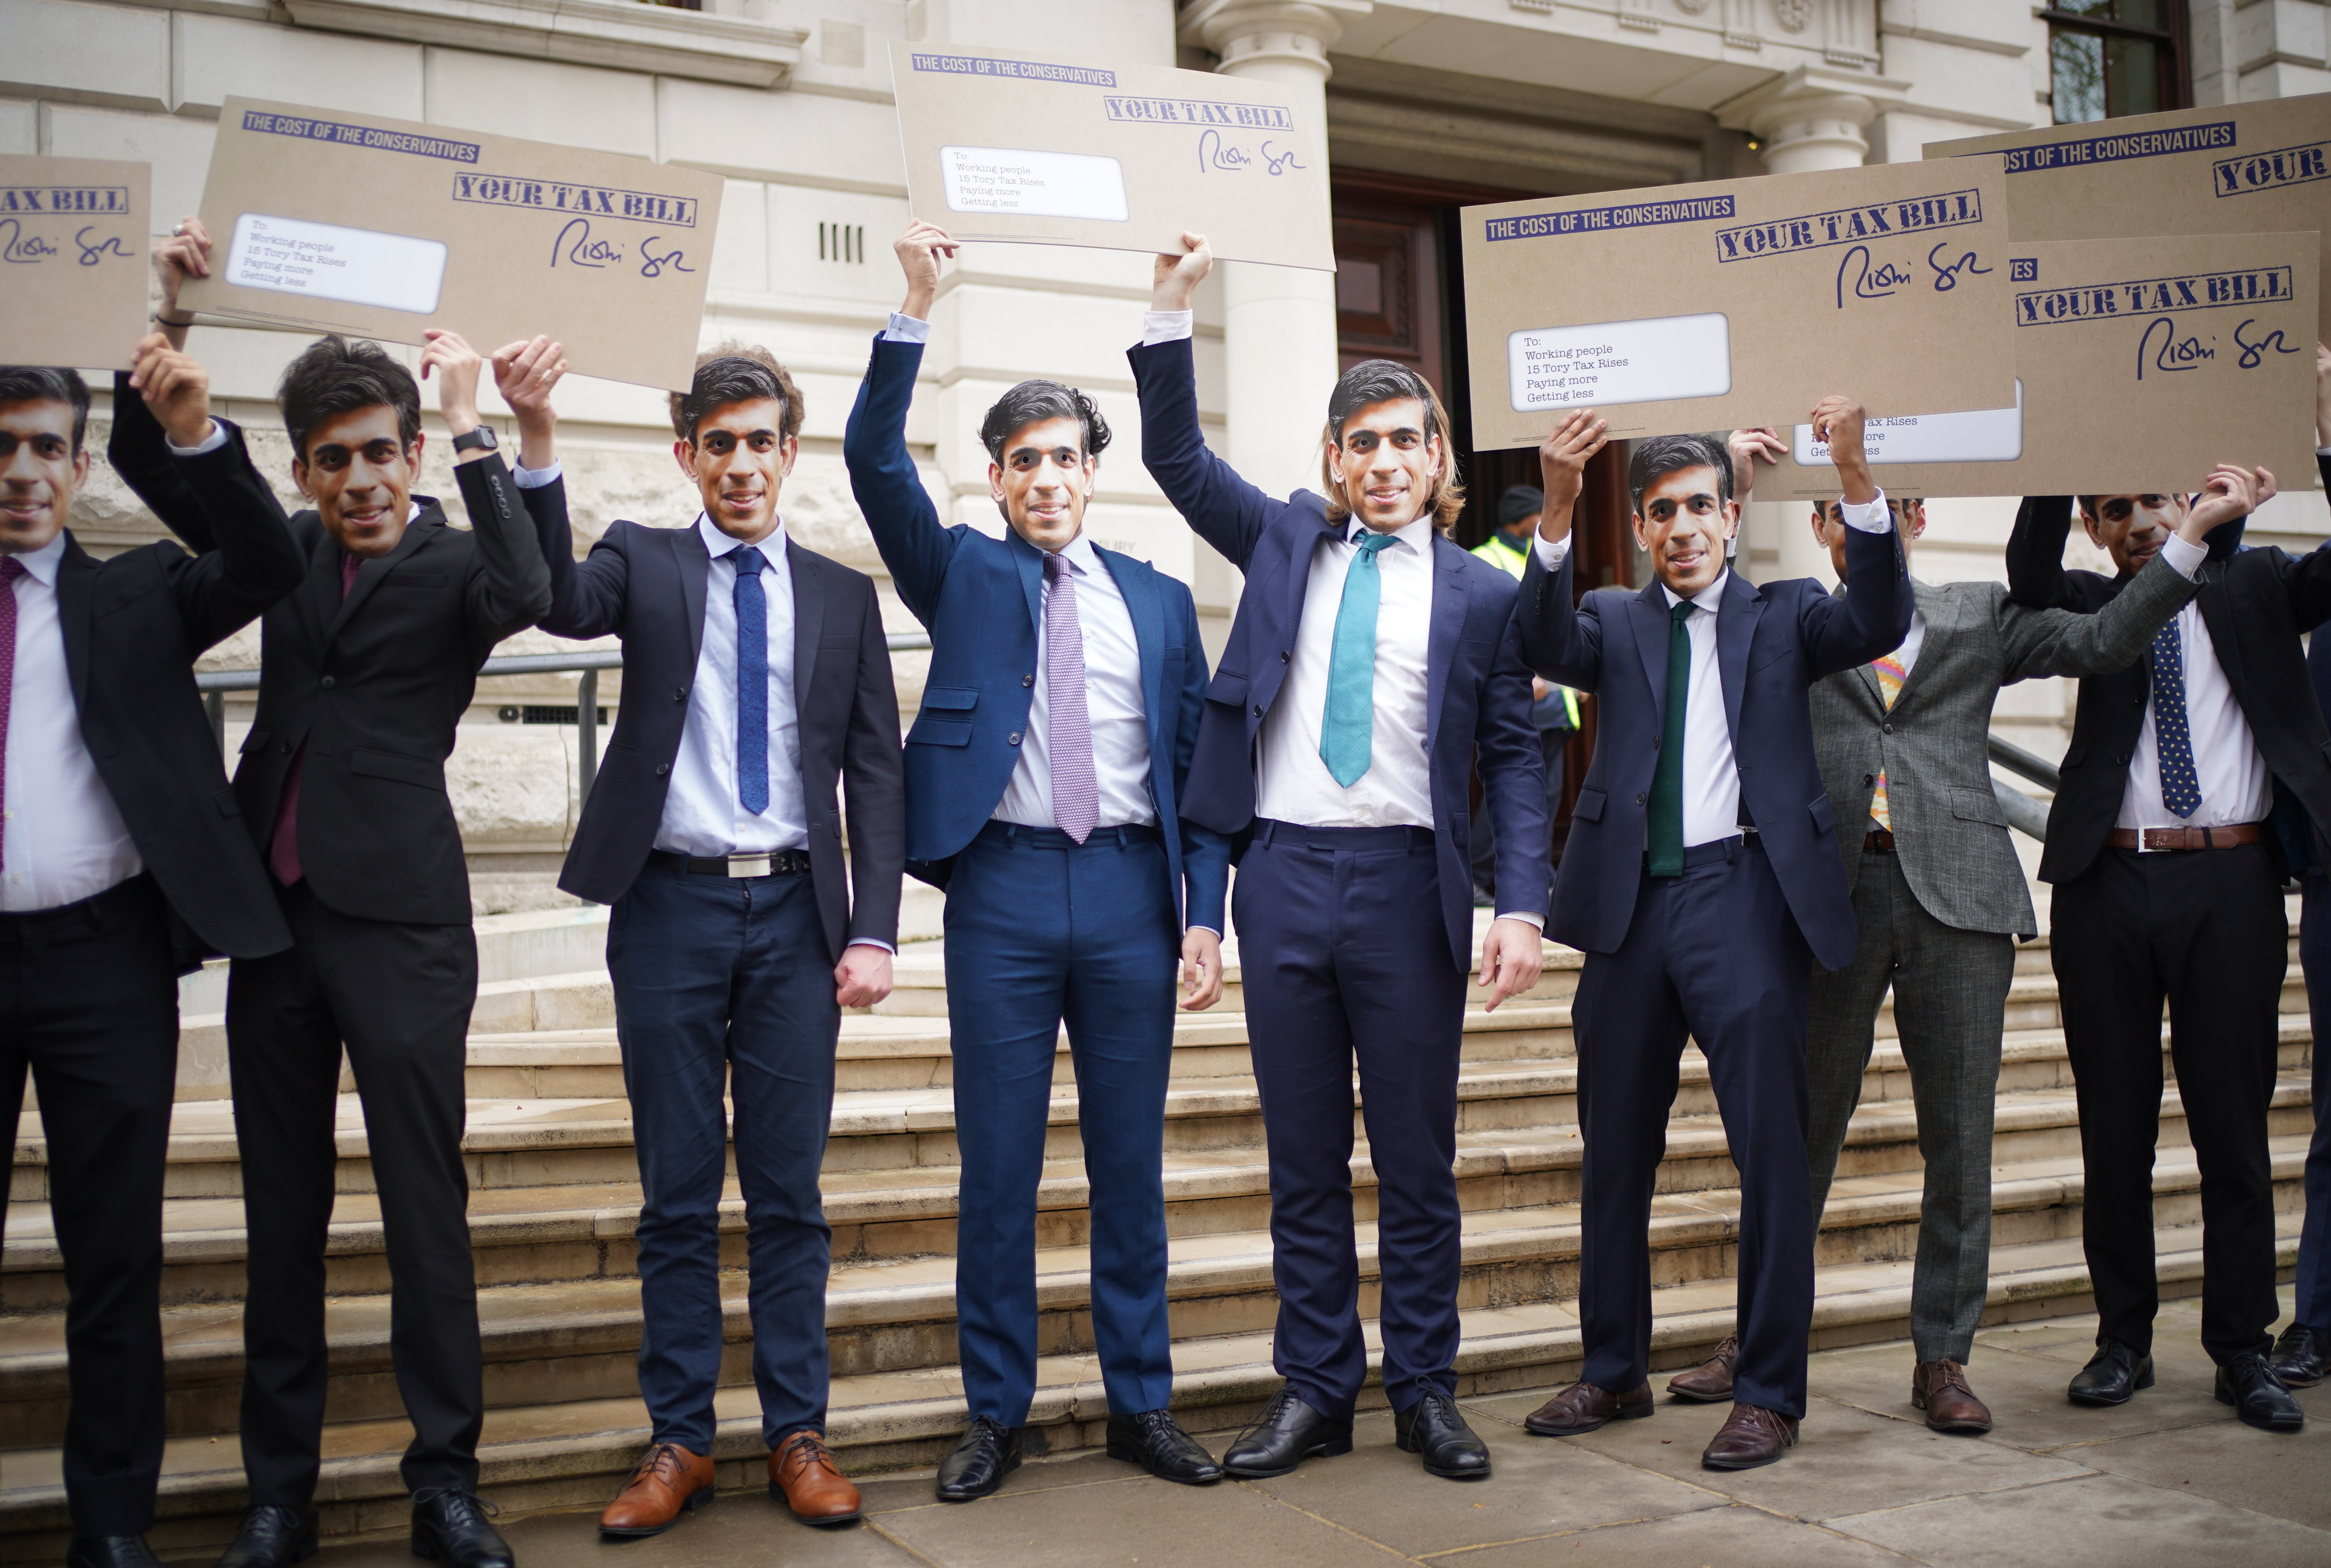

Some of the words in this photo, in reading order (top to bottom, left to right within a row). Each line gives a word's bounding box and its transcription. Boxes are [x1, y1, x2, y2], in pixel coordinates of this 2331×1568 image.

[914, 56, 939, 70] THE
[941, 58, 972, 71] COST
[976, 61, 990, 73] OF
[993, 62, 1018, 75] THE
[1020, 64, 1113, 85] CONSERVATIVES
[1107, 99, 1178, 120] YOUR
[1180, 103, 1232, 123] TAX
[1235, 106, 1289, 127] BILL
[246, 113, 273, 130] THE
[275, 118, 311, 135] COST
[314, 123, 332, 138] OF
[336, 126, 363, 143] THE
[364, 130, 475, 160] CONSERVATIVES
[2034, 147, 2054, 166] OF
[2059, 143, 2091, 163] THE
[2096, 125, 2230, 159] CONSERVATIVES
[955, 163, 997, 174] Working
[999, 167, 1031, 175] people
[2218, 148, 2327, 190] YOUR
[972, 175, 996, 185] Tory
[1019, 178, 1045, 186] Rises
[458, 176, 542, 205] YOUR
[552, 186, 615, 213] TAX
[624, 195, 691, 223] BILL
[959, 186, 993, 196] Paying
[52, 190, 122, 210] BILL
[961, 197, 998, 207] Getting
[252, 220, 268, 230] To:
[1488, 220, 1516, 238] THE
[1519, 216, 1556, 235] COST
[1560, 214, 1577, 230] OF
[1581, 211, 1610, 228] THE
[1613, 199, 1730, 225] CONSERVATIVES
[1720, 221, 1814, 256] YOUR
[1819, 207, 1891, 240] TAX
[1899, 195, 1977, 229] BILL
[250, 233, 296, 248] Working
[297, 241, 334, 252] people
[246, 245, 261, 254] 15
[263, 247, 291, 260] Tory
[293, 251, 314, 262] Tax
[316, 255, 346, 267] Rises
[244, 258, 283, 272] Paying
[283, 265, 314, 275] more
[240, 270, 282, 284] Getting
[284, 276, 306, 287] less
[2020, 289, 2117, 321] YOUR
[2125, 280, 2198, 310] TAX
[2206, 272, 2287, 303] BILL
[1524, 337, 1540, 346] To:
[1525, 348, 1573, 360] Working
[1575, 345, 1612, 358] people
[1527, 365, 1540, 374] 15
[1543, 364, 1570, 373] Tory
[1573, 361, 1594, 370] Tax
[1598, 359, 1628, 368] Rises
[1526, 377, 1565, 389] Paying
[1568, 376, 1598, 385] more
[1528, 391, 1569, 402] Getting
[1572, 390, 1594, 398] less
[1886, 417, 1918, 426] Rises
